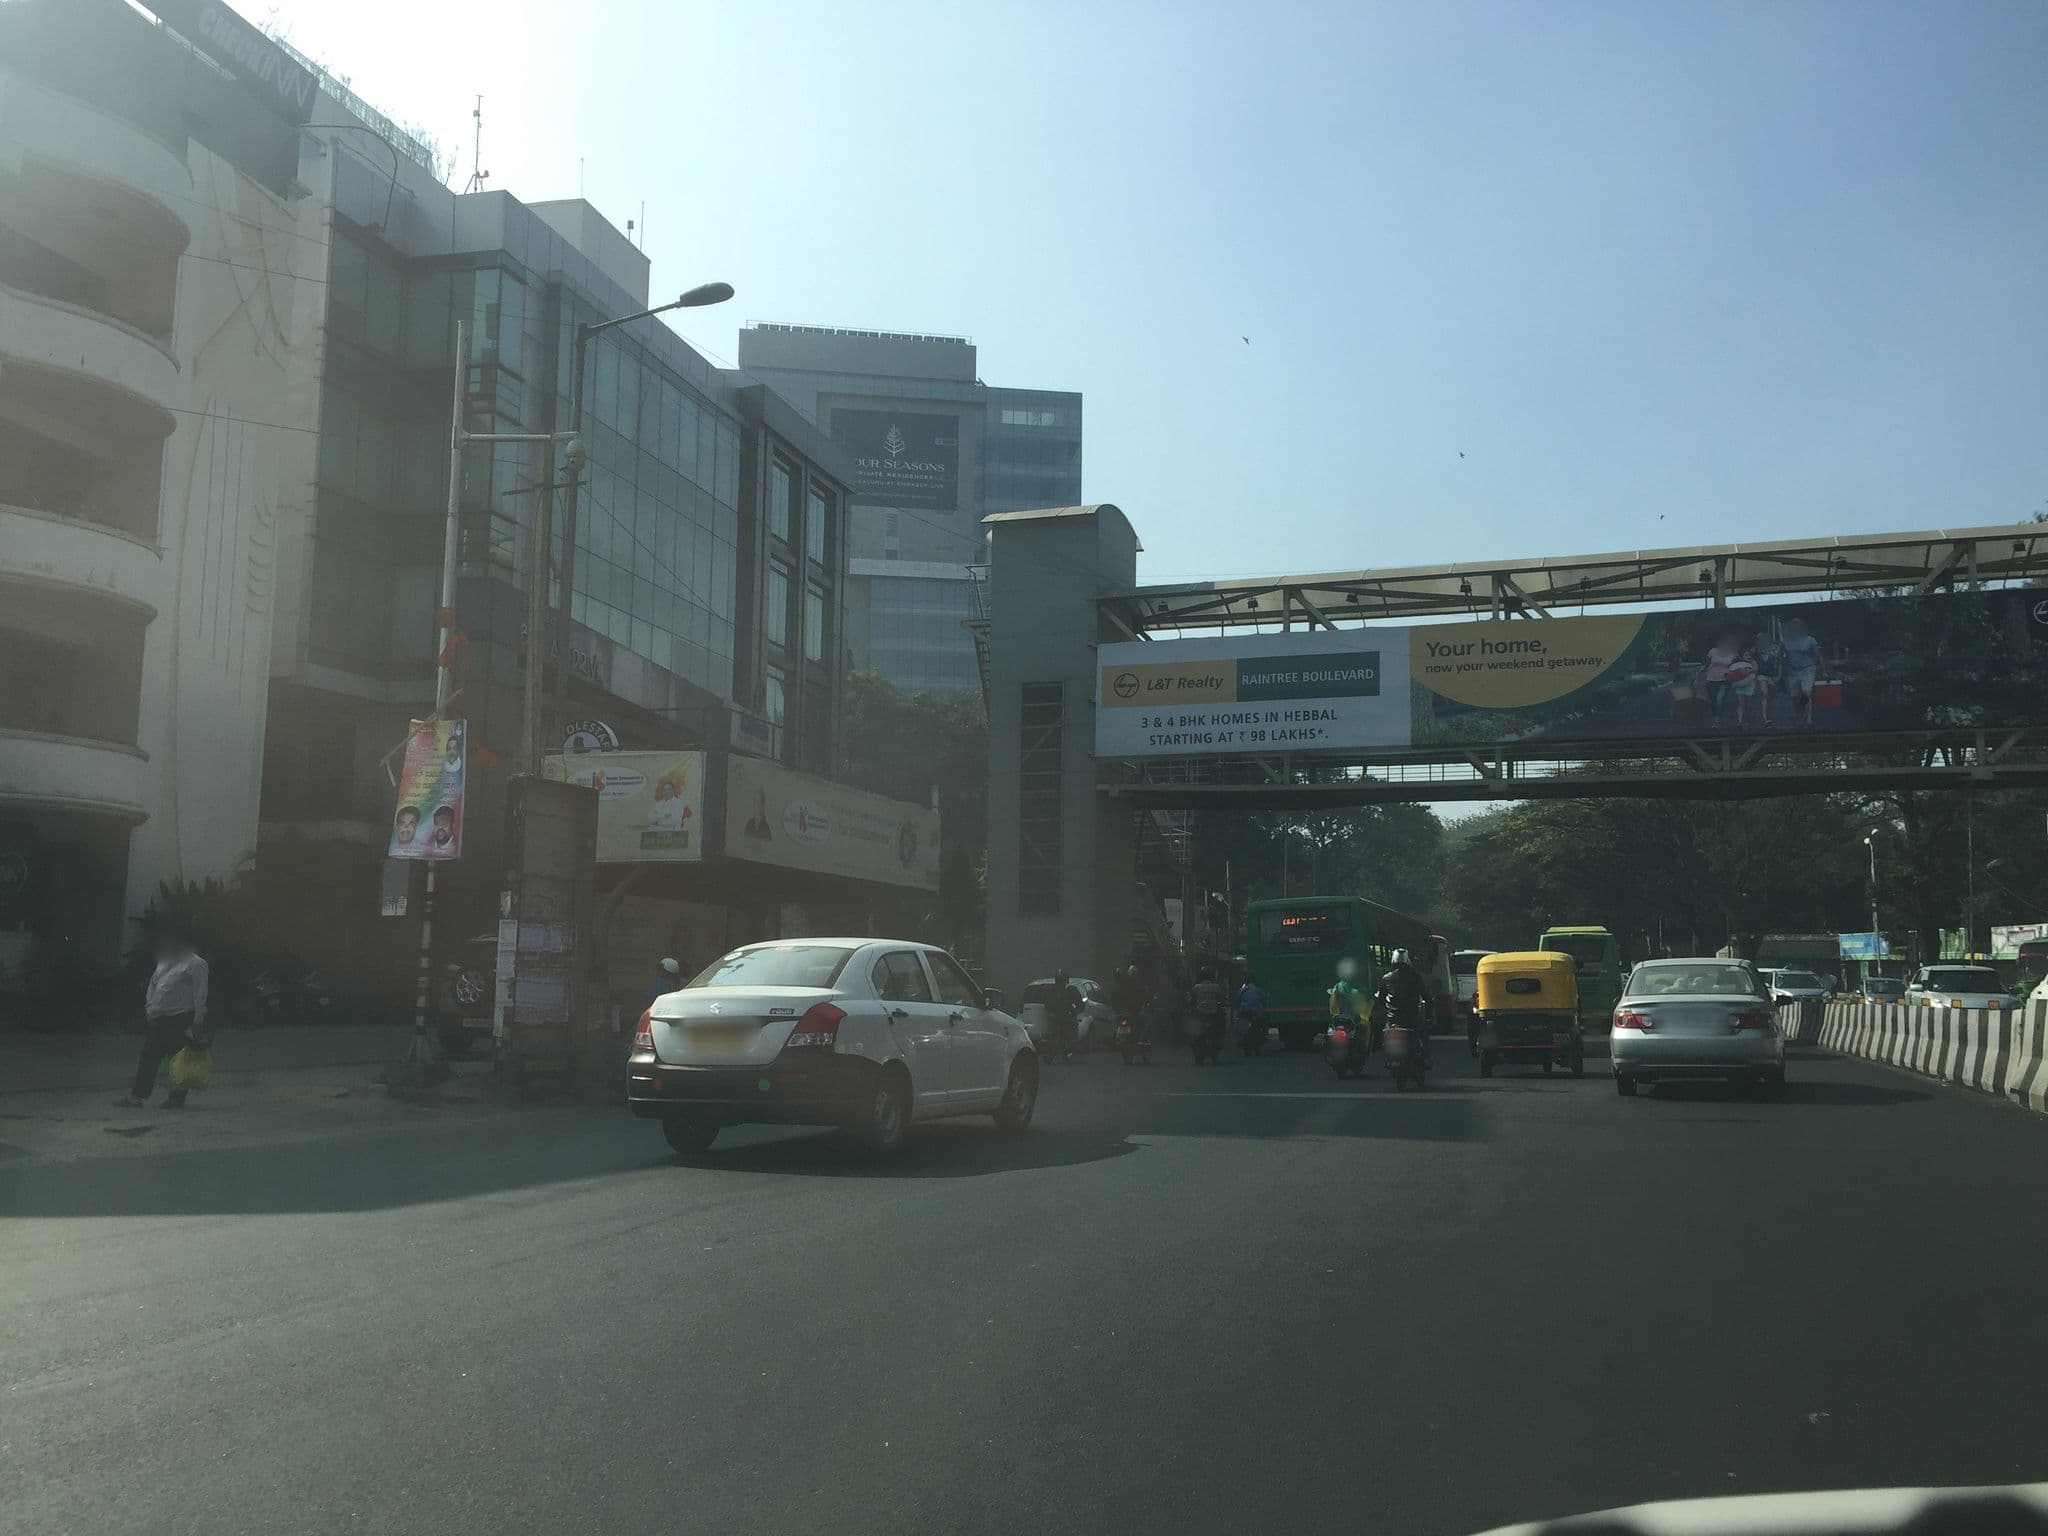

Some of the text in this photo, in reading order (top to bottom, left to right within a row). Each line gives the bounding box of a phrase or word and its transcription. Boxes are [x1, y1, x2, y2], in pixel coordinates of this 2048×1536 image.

[884, 459, 945, 473] SEASONS
[1426, 638, 1548, 658] Your home,
[1425, 654, 1606, 675] now your weekend getaway.
[1147, 676, 1224, 691] L&T Realty
[1241, 667, 1375, 686] RAINTREE BOULEVARD
[1141, 709, 1338, 729] 3 & 4 BHK HOMES IN HEBBAL
[1149, 732, 1213, 746] STARTING
[1217, 730, 1234, 744] AT
[1250, 729, 1266, 742] 98
